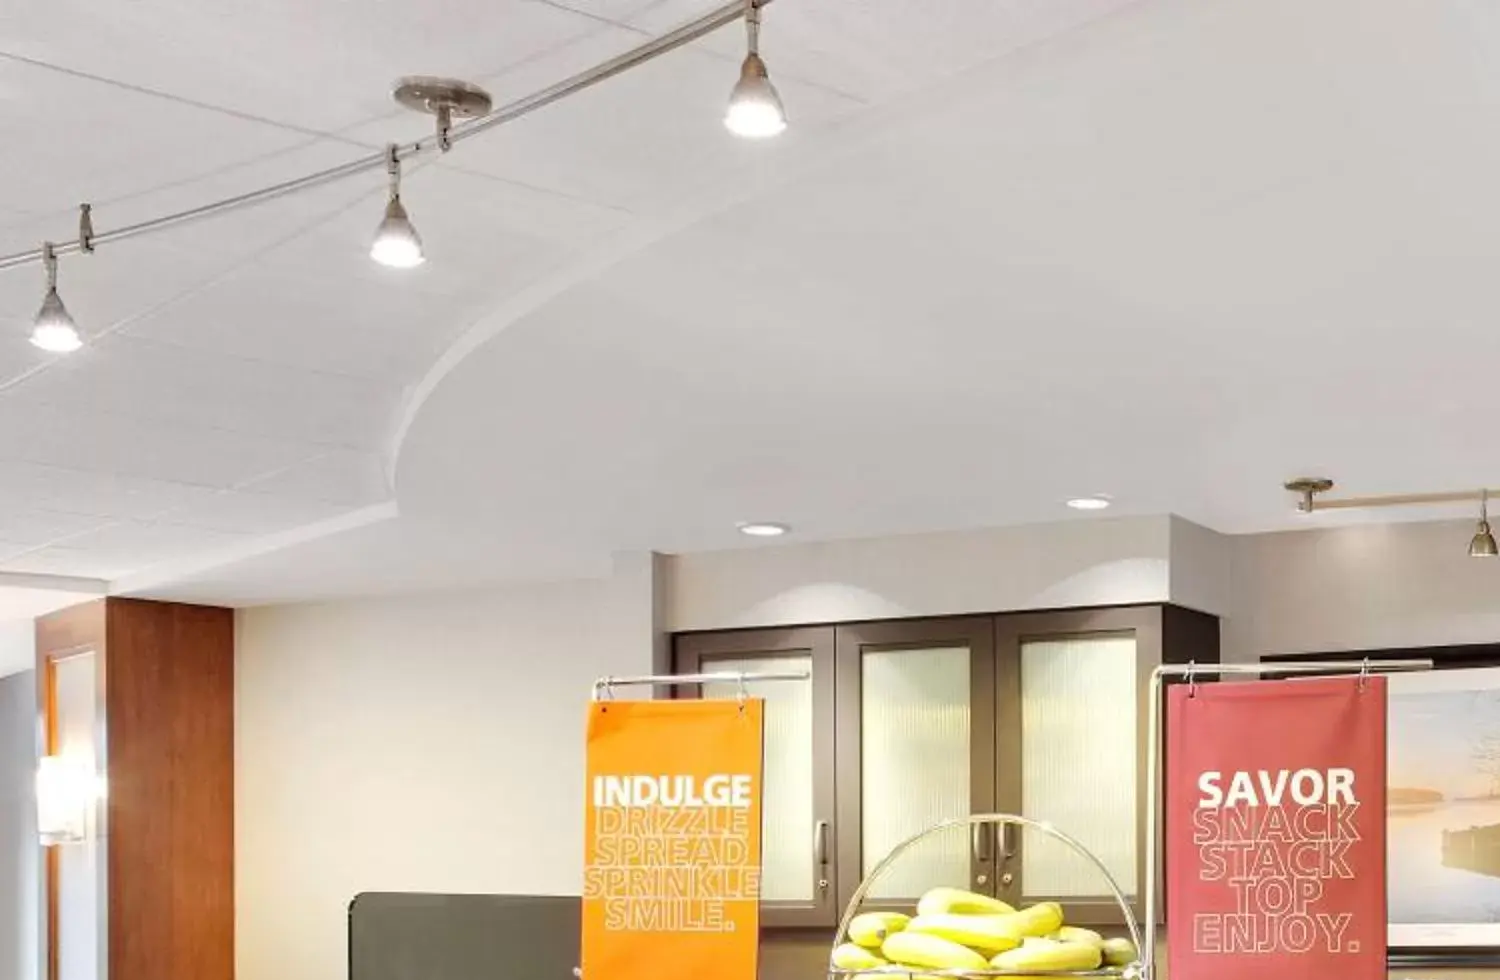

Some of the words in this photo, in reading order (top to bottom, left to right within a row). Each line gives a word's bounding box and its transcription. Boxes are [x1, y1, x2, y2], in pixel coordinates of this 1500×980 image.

[593, 774, 752, 807] INDULGE
[1198, 768, 1358, 807] SAVOR
[596, 806, 749, 837] DRIZZLE
[1193, 802, 1361, 844] SNACK
[595, 834, 748, 867] SPREAD
[1199, 839, 1355, 880] STACK
[584, 865, 762, 899] SPRINKLE
[1228, 876, 1323, 916] TOP
[605, 897, 736, 932] SMILE.
[1194, 913, 1360, 953] ENJOY.
